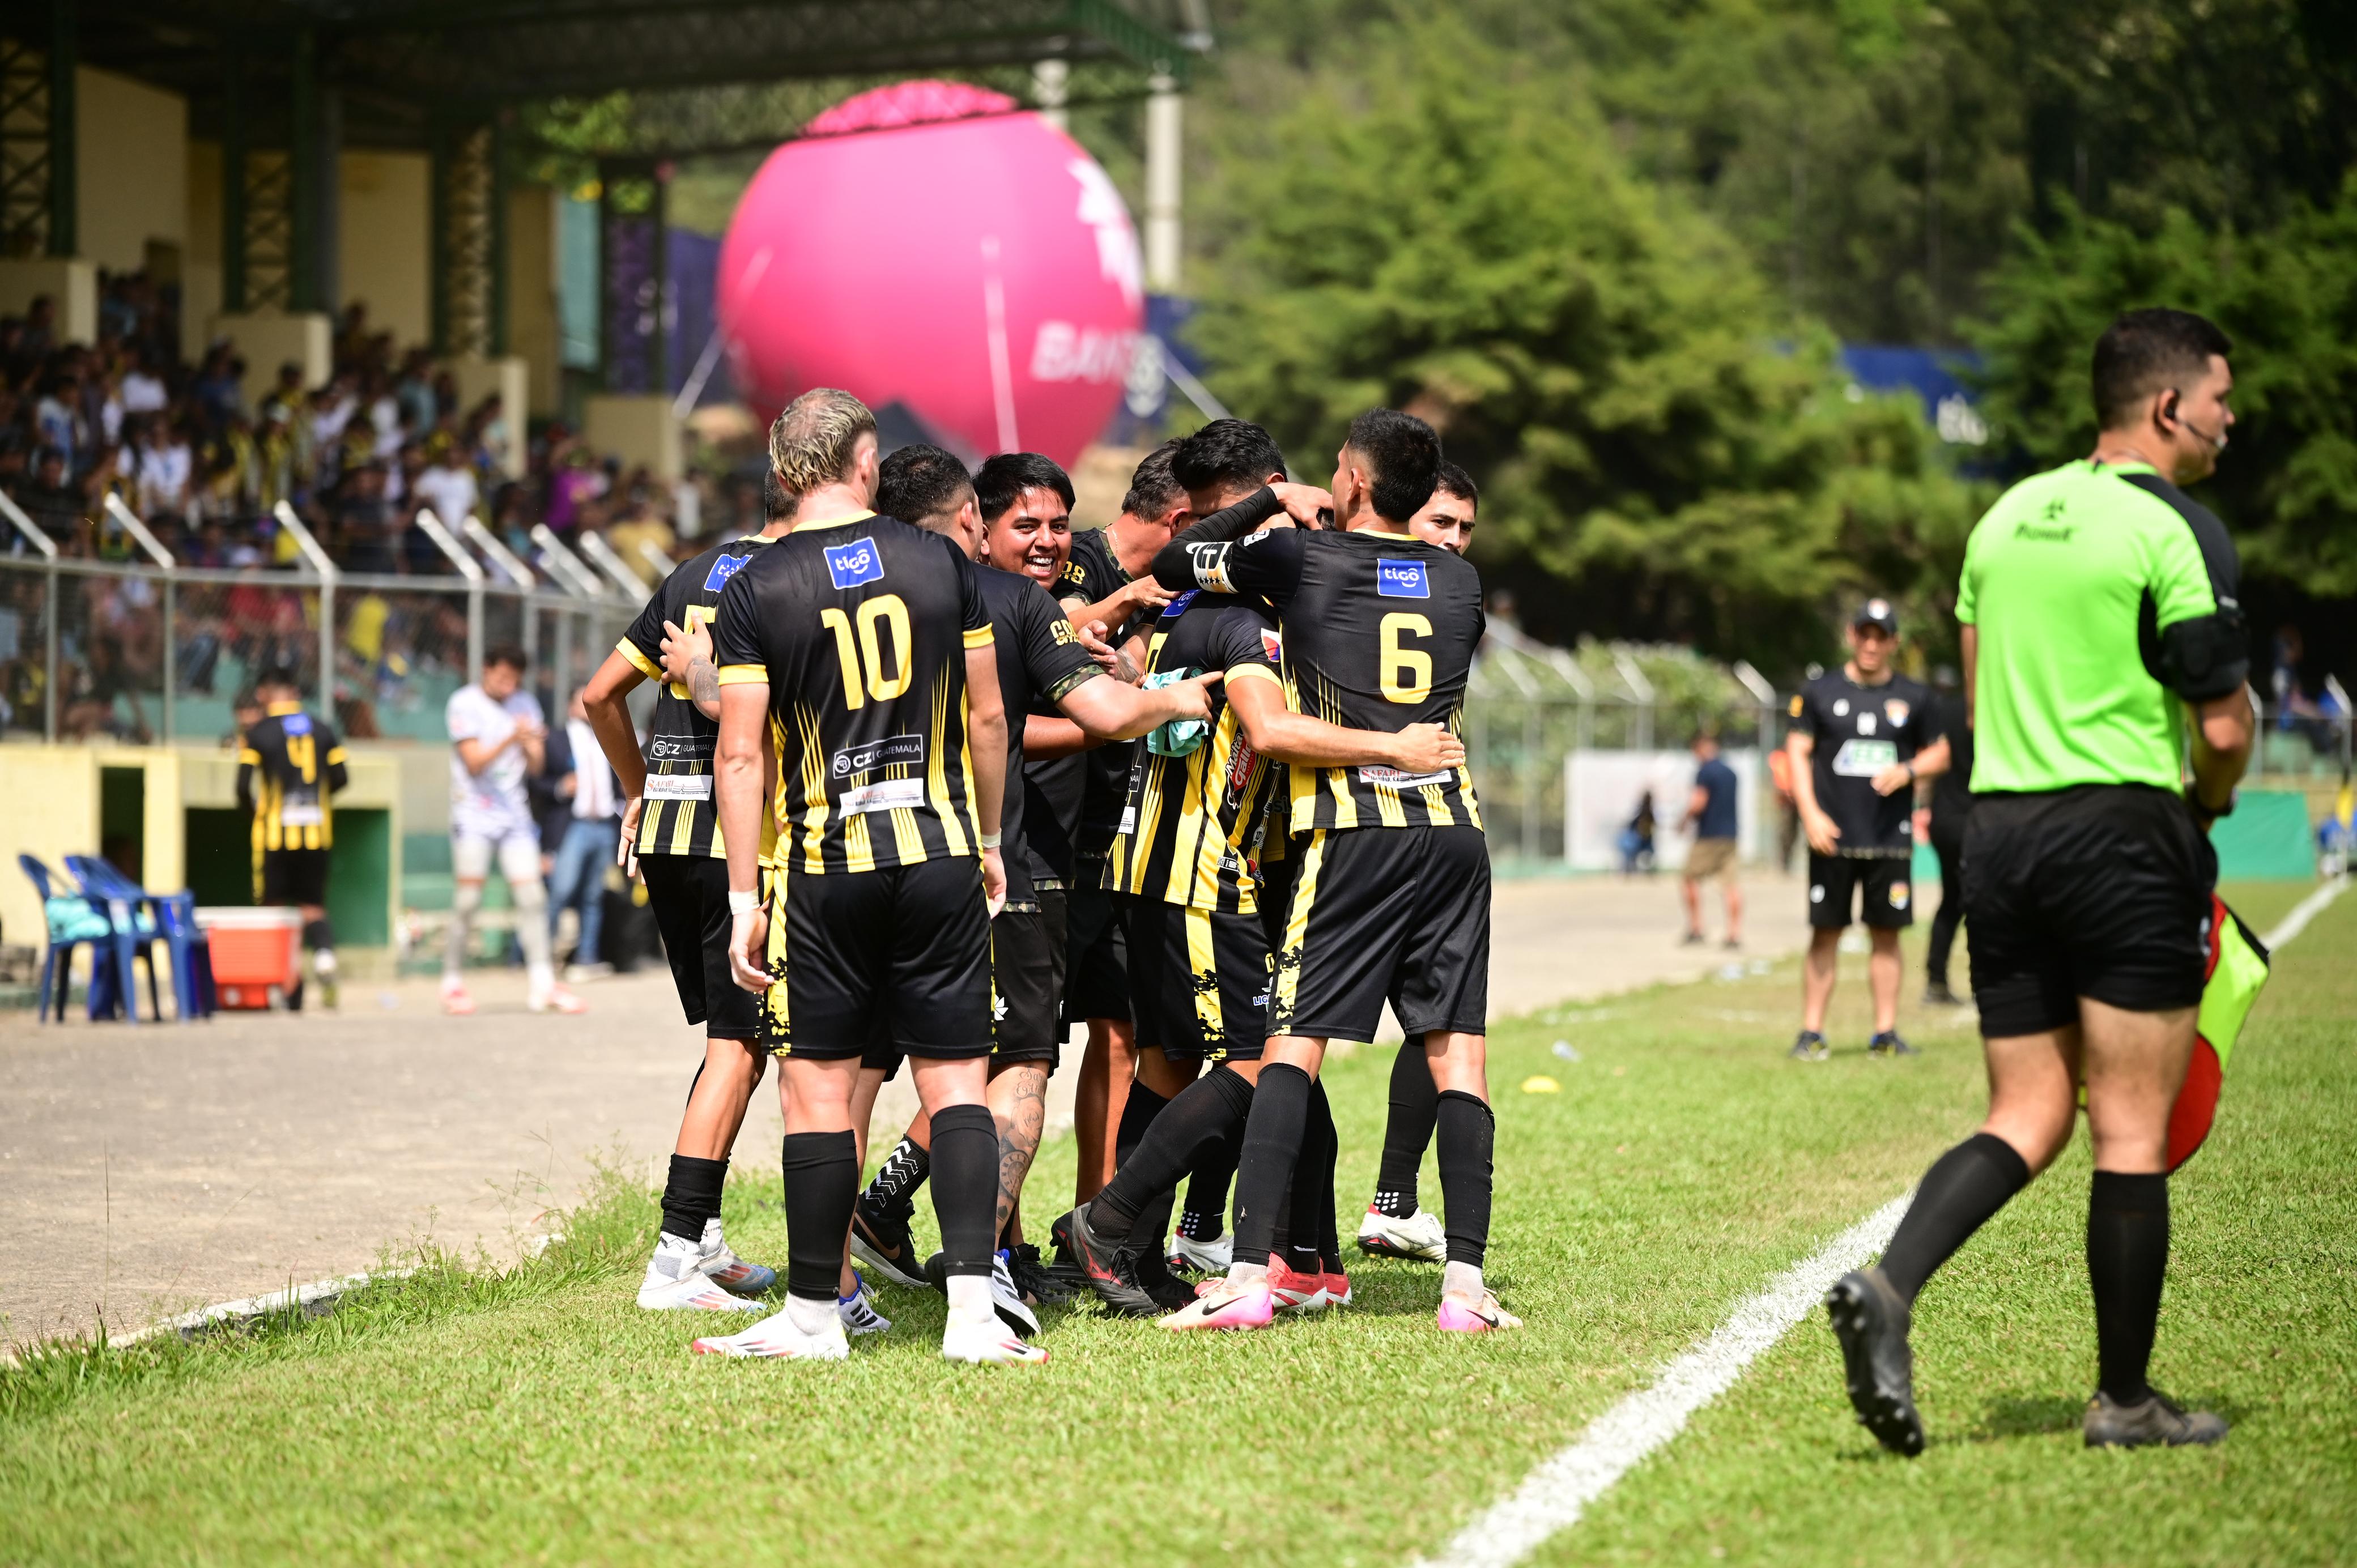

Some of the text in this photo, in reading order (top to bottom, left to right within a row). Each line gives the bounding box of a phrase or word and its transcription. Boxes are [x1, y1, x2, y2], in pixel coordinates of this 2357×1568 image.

[1028, 321, 1135, 384] BAN
[821, 594, 911, 710] 10
[1380, 612, 1433, 704] 6
[286, 734, 317, 785] 4
[666, 743, 681, 755] CZ
[853, 744, 921, 768] CZ GATEMALA
[1226, 734, 1243, 777] Malta
[1362, 769, 1401, 779] SAFARI
[1253, 994, 1270, 1006] LIG
